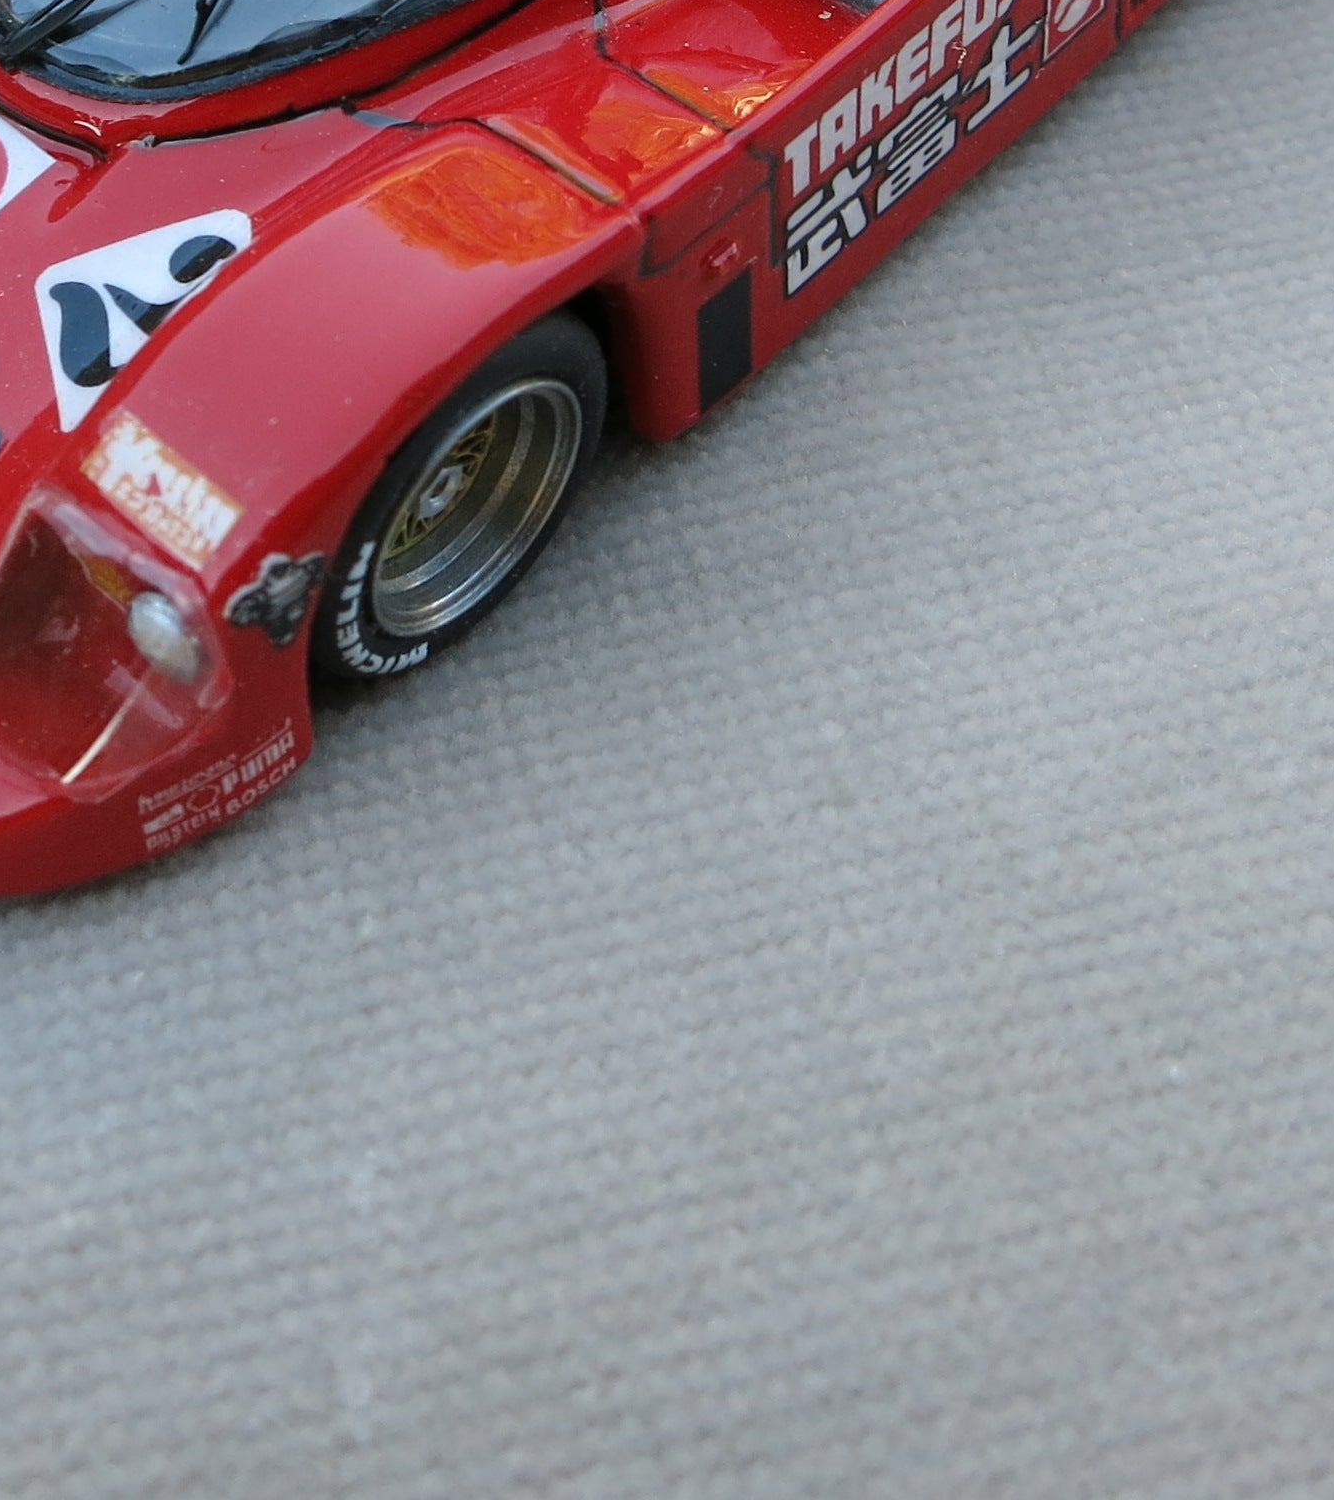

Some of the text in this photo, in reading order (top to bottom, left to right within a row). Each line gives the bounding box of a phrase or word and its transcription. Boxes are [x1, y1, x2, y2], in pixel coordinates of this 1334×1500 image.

[785, 15, 1043, 298] 武富士
[335, 540, 429, 675] MICHELIN
[225, 756, 298, 816] BOSCH
